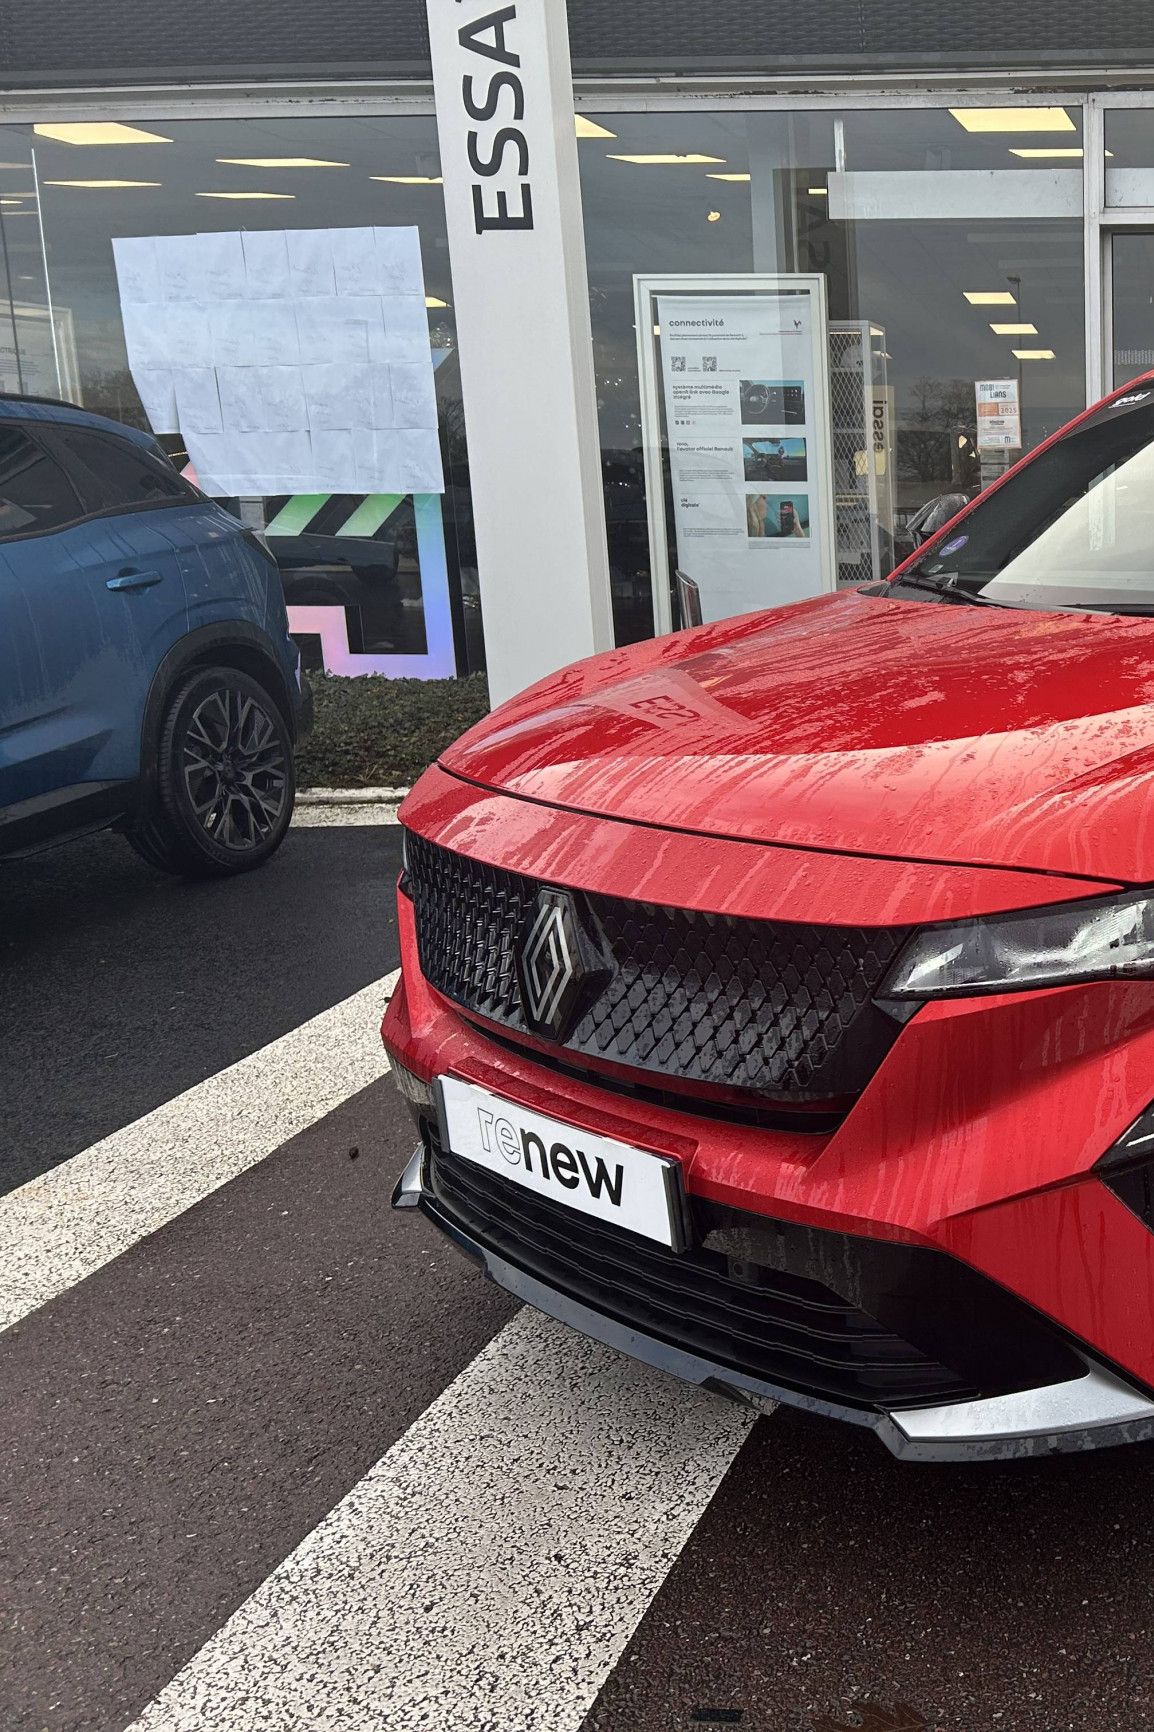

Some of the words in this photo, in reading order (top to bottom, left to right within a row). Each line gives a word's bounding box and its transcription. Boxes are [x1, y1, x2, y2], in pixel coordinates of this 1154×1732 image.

[459, 0, 534, 235] ESSA
[669, 318, 725, 327] connectivité
[477, 1107, 625, 1210] renew
